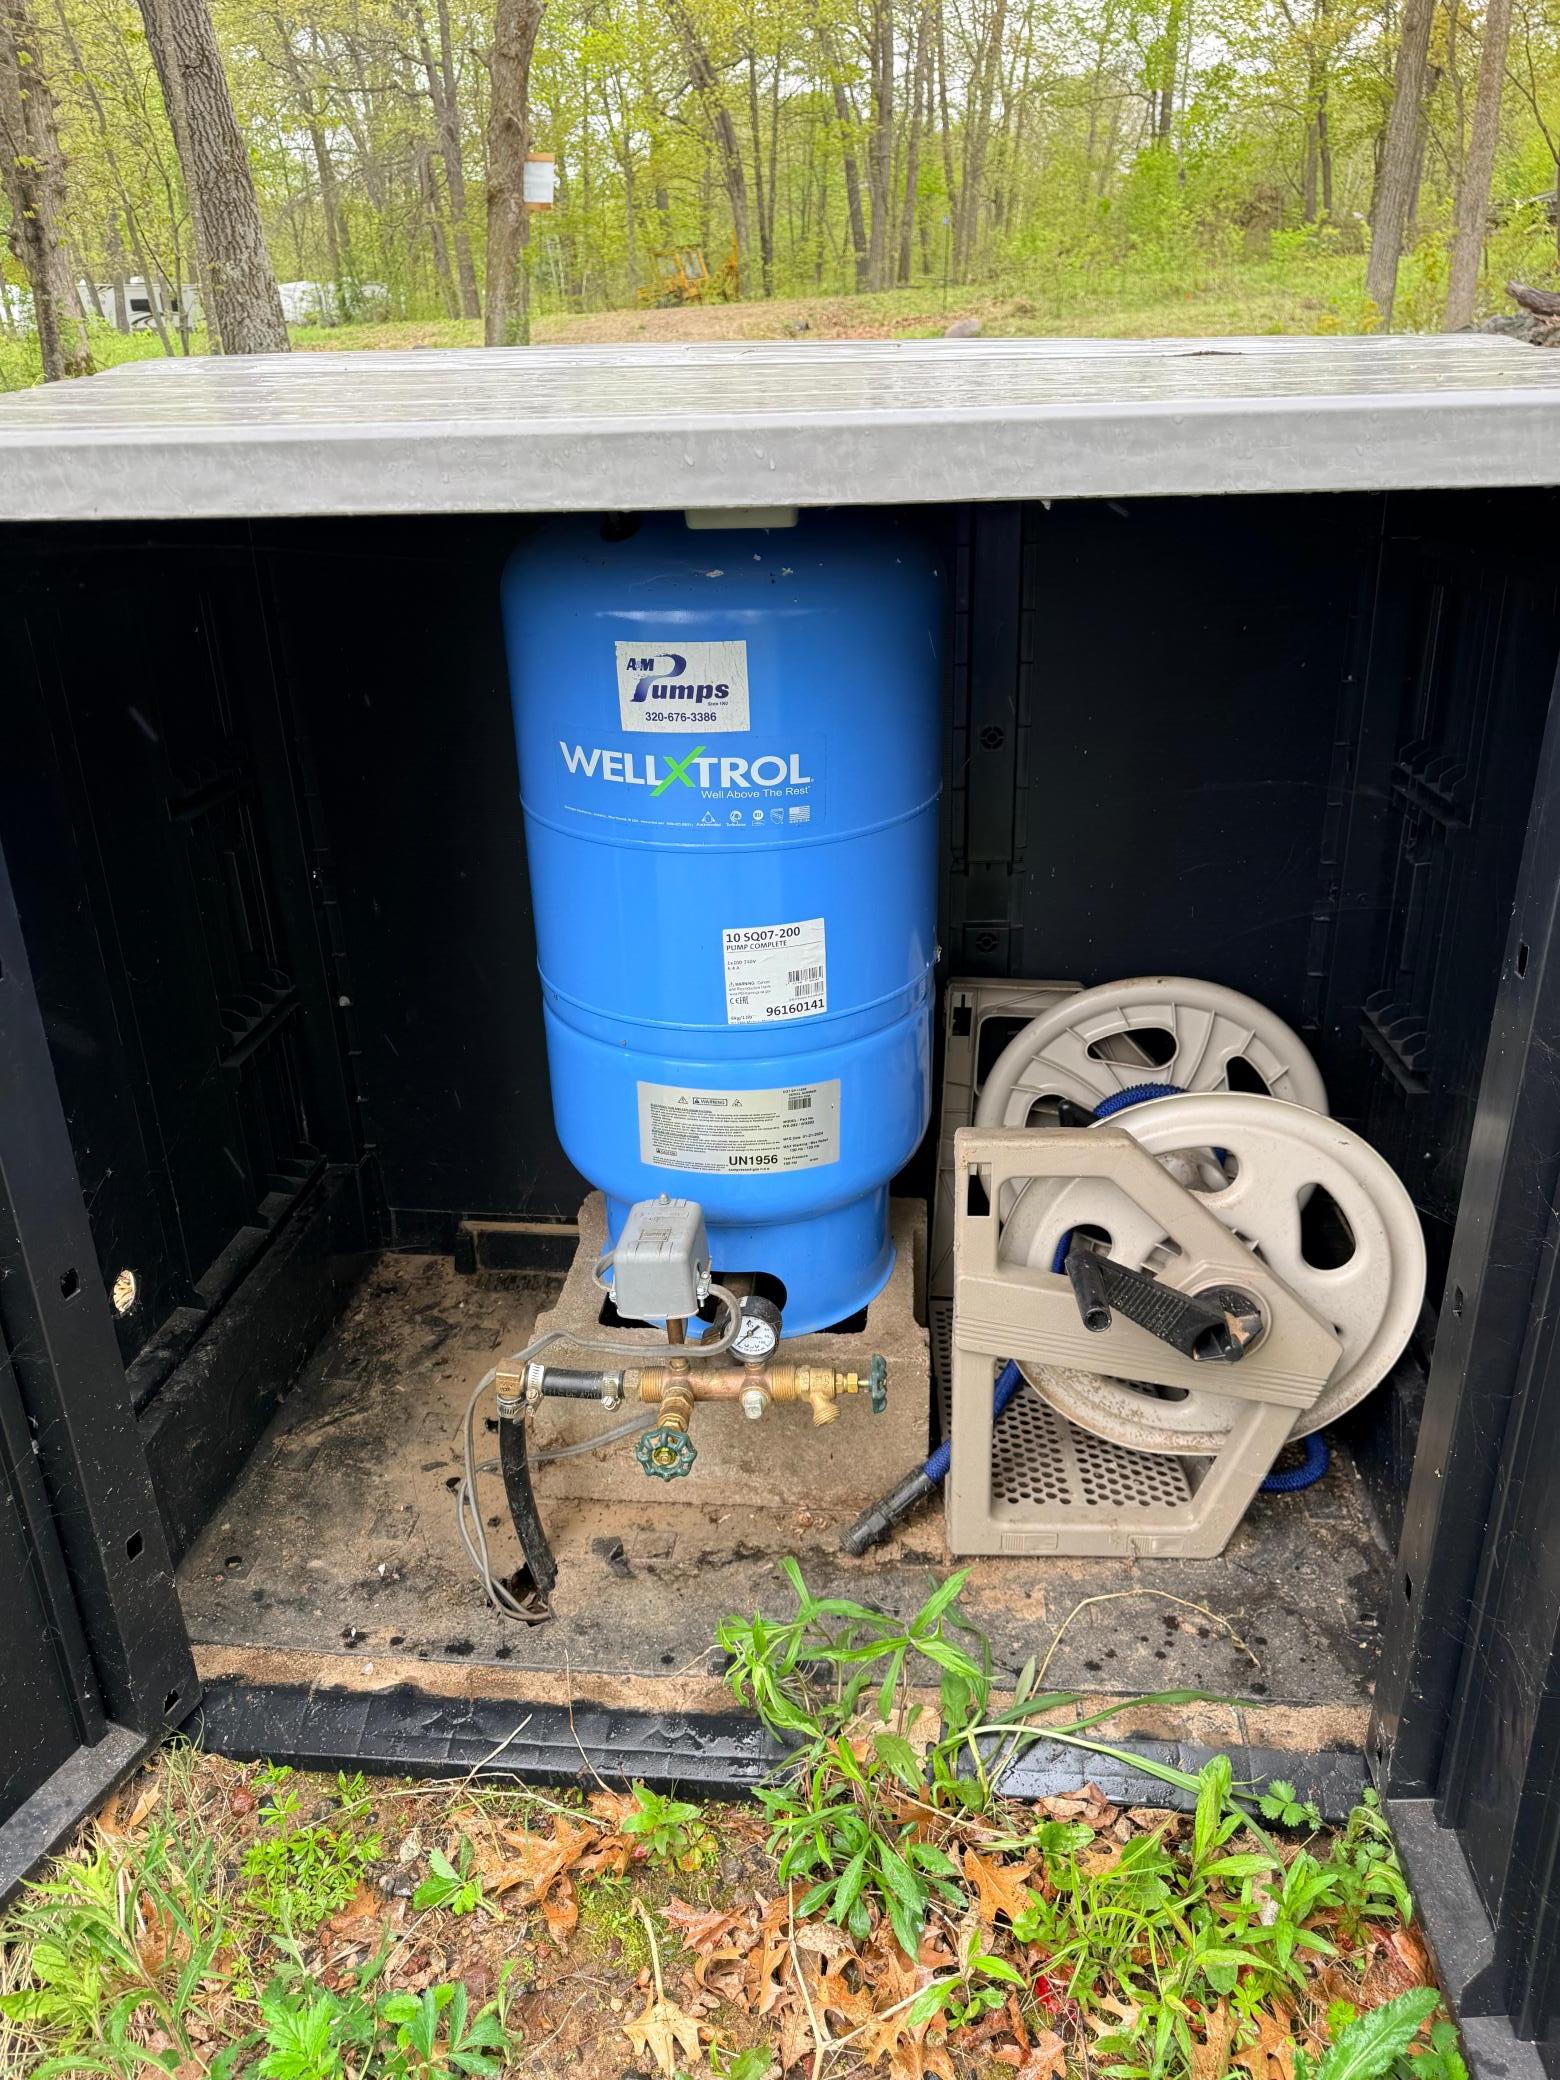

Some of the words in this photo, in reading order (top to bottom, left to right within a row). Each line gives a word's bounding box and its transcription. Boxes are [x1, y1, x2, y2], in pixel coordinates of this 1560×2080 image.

[645, 712, 717, 722] 320-676-3386
[701, 790, 724, 799] Well
[726, 790, 760, 799] Above
[762, 788, 783, 797] The
[785, 787, 809, 796] Rest
[726, 933, 741, 943] 10
[744, 926, 801, 942] SQ07-200
[750, 940, 788, 950] COMPLETE
[766, 998, 825, 1017] 96160141
[728, 1154, 779, 1166] UN1956
